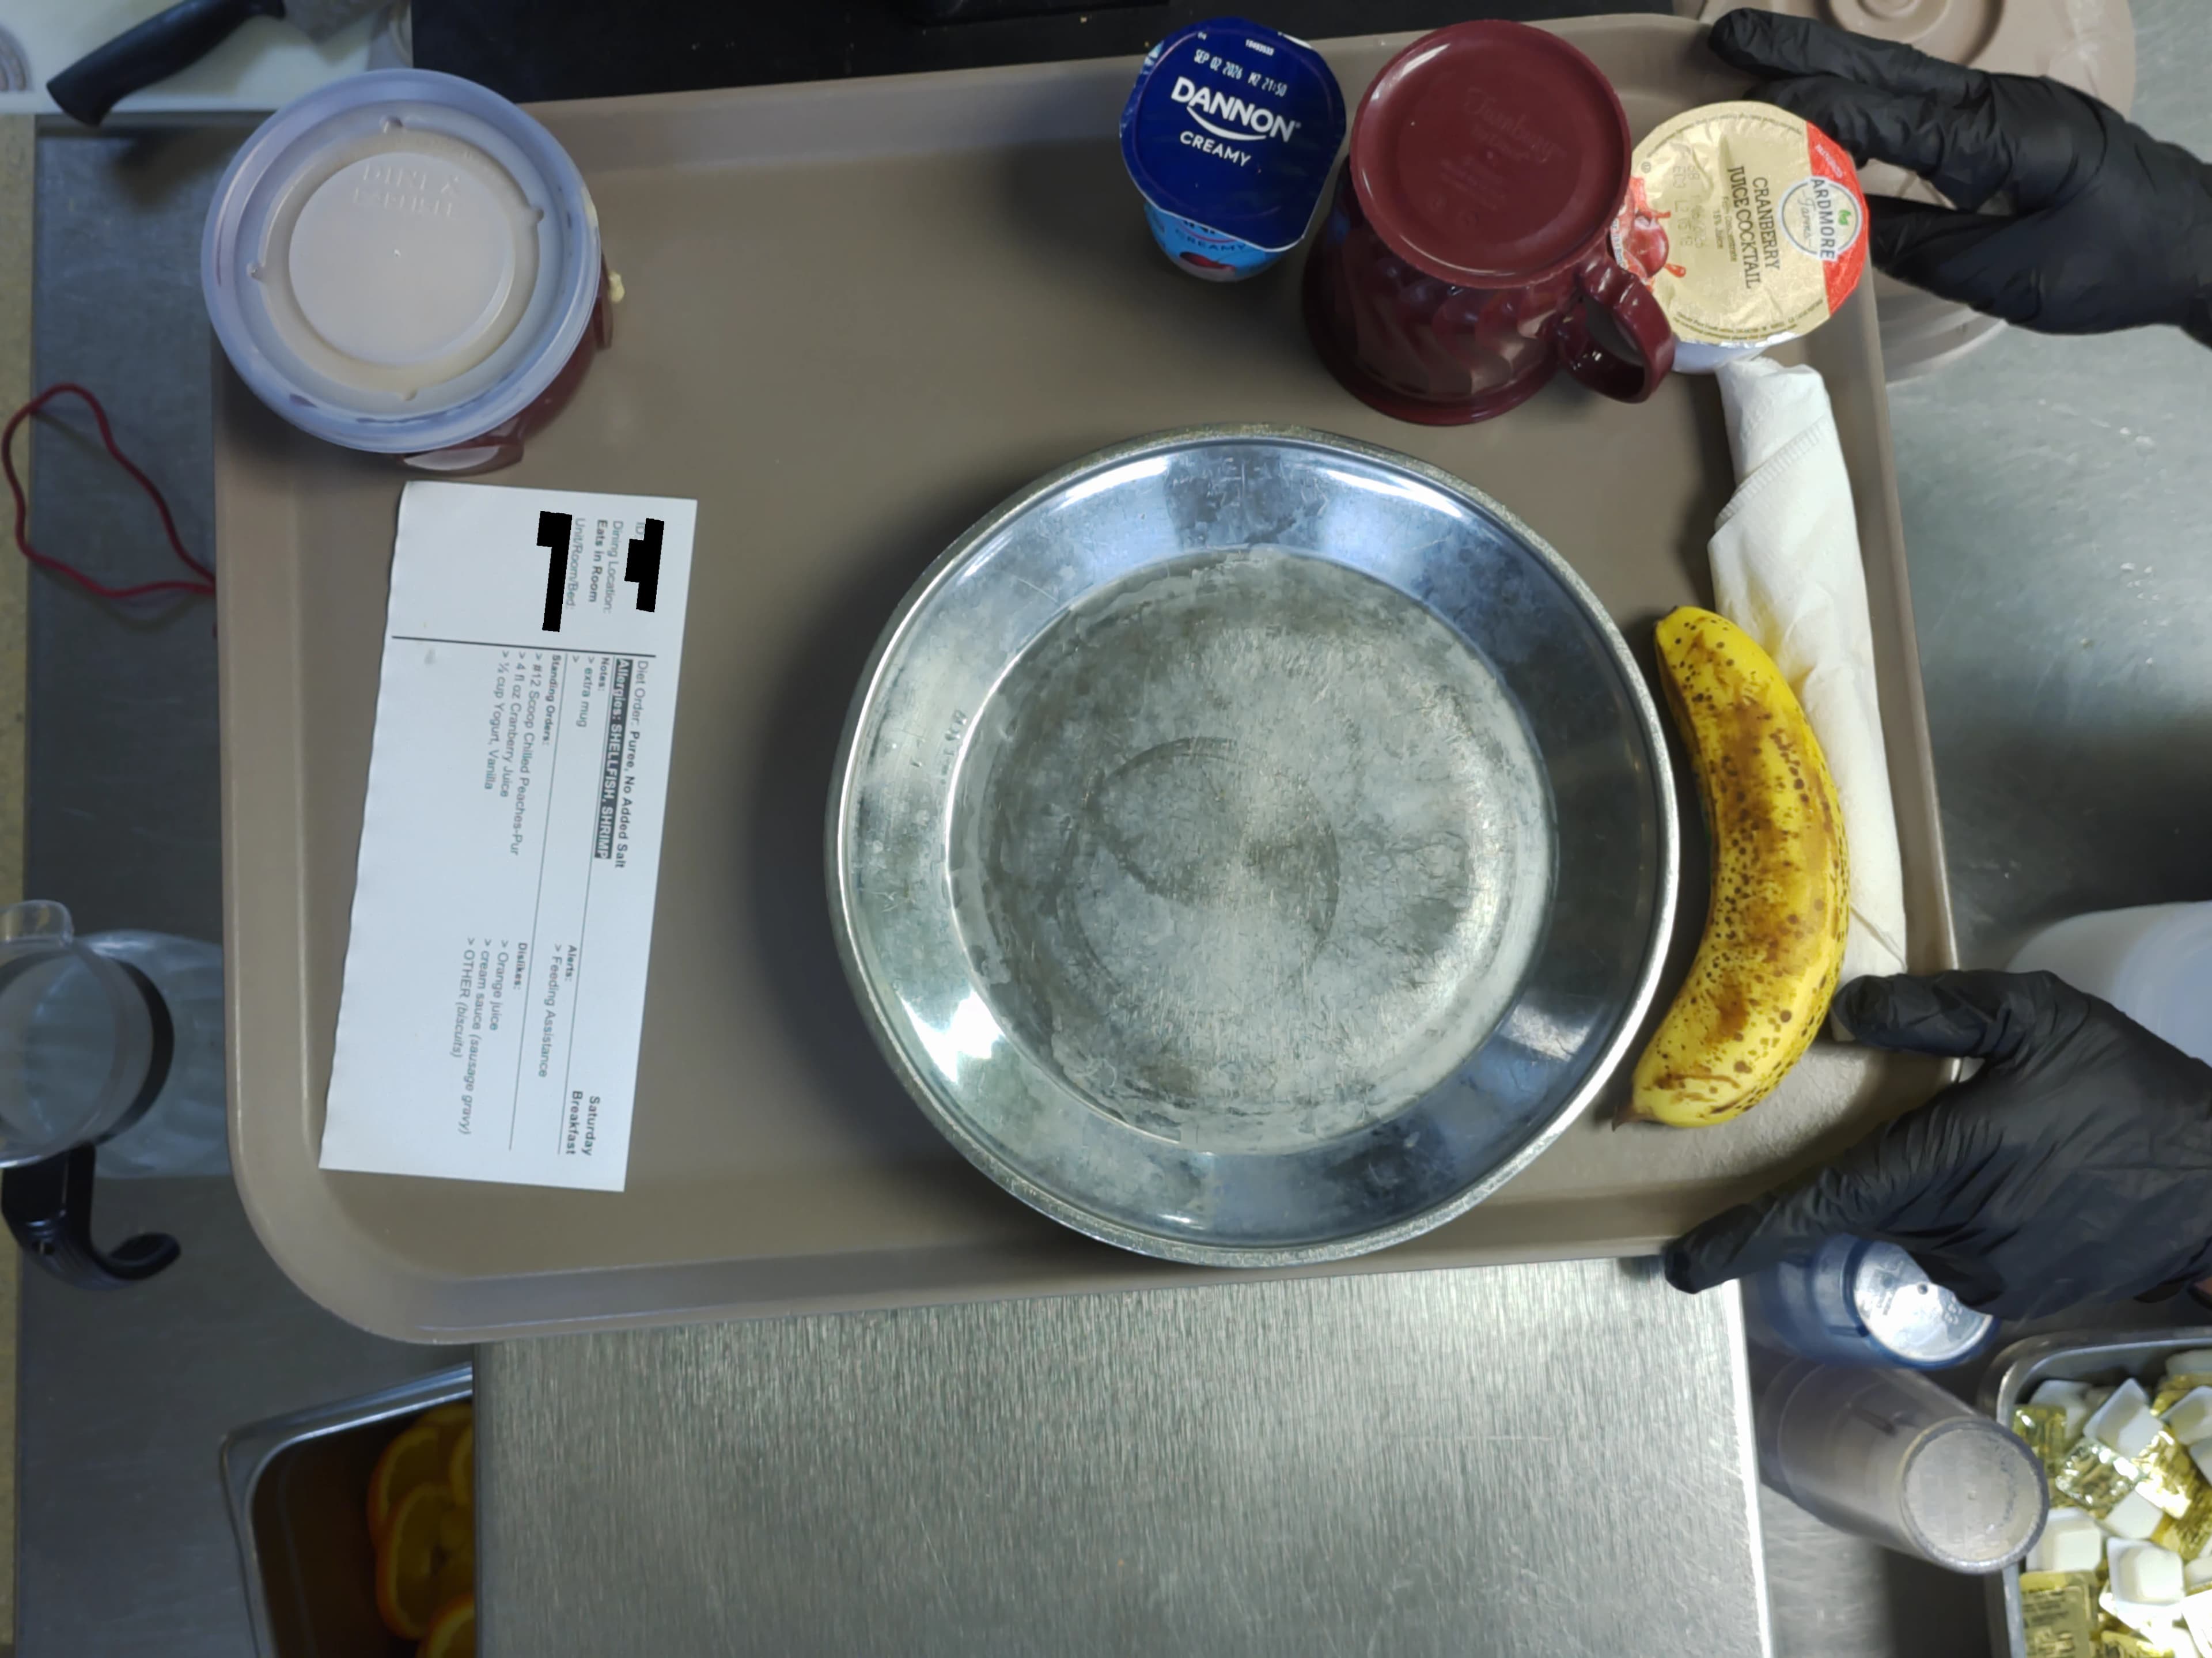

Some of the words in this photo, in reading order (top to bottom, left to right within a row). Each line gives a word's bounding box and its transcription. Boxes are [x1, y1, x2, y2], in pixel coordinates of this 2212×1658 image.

[1171, 76, 1295, 143] DANNON
[1180, 131, 1251, 167] CREAMY
[1728, 166, 1750, 207] JUICE
[1752, 176, 1781, 270] CRANBERRY
[1810, 179, 1836, 259] ARDMORE
[1736, 209, 1762, 289] COCKTAIL
[594, 519, 608, 547] Eats
[607, 520, 624, 558] Dining
[565, 518, 586, 609] Unit/Room/Bed:
[593, 550, 604, 562] in
[588, 565, 603, 603] Room
[603, 561, 619, 613] Location:
[493, 676, 506, 699] cup
[511, 684, 521, 699] oz
[530, 664, 543, 687] #12
[545, 654, 562, 702] Standing
[581, 667, 593, 698] extra
[598, 657, 610, 691] Notes:
[609, 658, 630, 721] Allergies:
[635, 660, 649, 684] Diet
[488, 702, 505, 745] Yogurt,
[523, 690, 540, 729] Scoop
[542, 705, 556, 745] Orders:
[575, 701, 589, 728] mug
[631, 687, 646, 726] Order:
[502, 702, 522, 763] Cranberry
[520, 732, 535, 774] Chilled
[624, 730, 641, 771] Puree,
[484, 749, 500, 790] Vanilla
[499, 765, 514, 798] Juice
[601, 722, 623, 804] SHELLFISH,
[623, 775, 635, 794] No
[510, 777, 531, 856] Peaches-Pur
[596, 805, 615, 859] SHRIMP
[618, 797, 633, 839] Added
[615, 843, 628, 868] Salt
[459, 949, 475, 998] OTHER
[477, 950, 490, 990] cream
[491, 952, 509, 998] Orange
[513, 942, 528, 990] Dislikes:
[543, 956, 563, 1006] Feeding
[565, 944, 578, 981] Alerts:
[449, 1001, 469, 1058] (biscuits)
[472, 993, 485, 1030] sauce
[489, 1001, 503, 1031] juice
[463, 1034, 482, 1092] (sausage
[538, 1009, 556, 1078] Assistance
[458, 1095, 473, 1135] gravy)
[566, 1091, 584, 1155] Breakfast
[581, 1096, 601, 1156] Saturday
